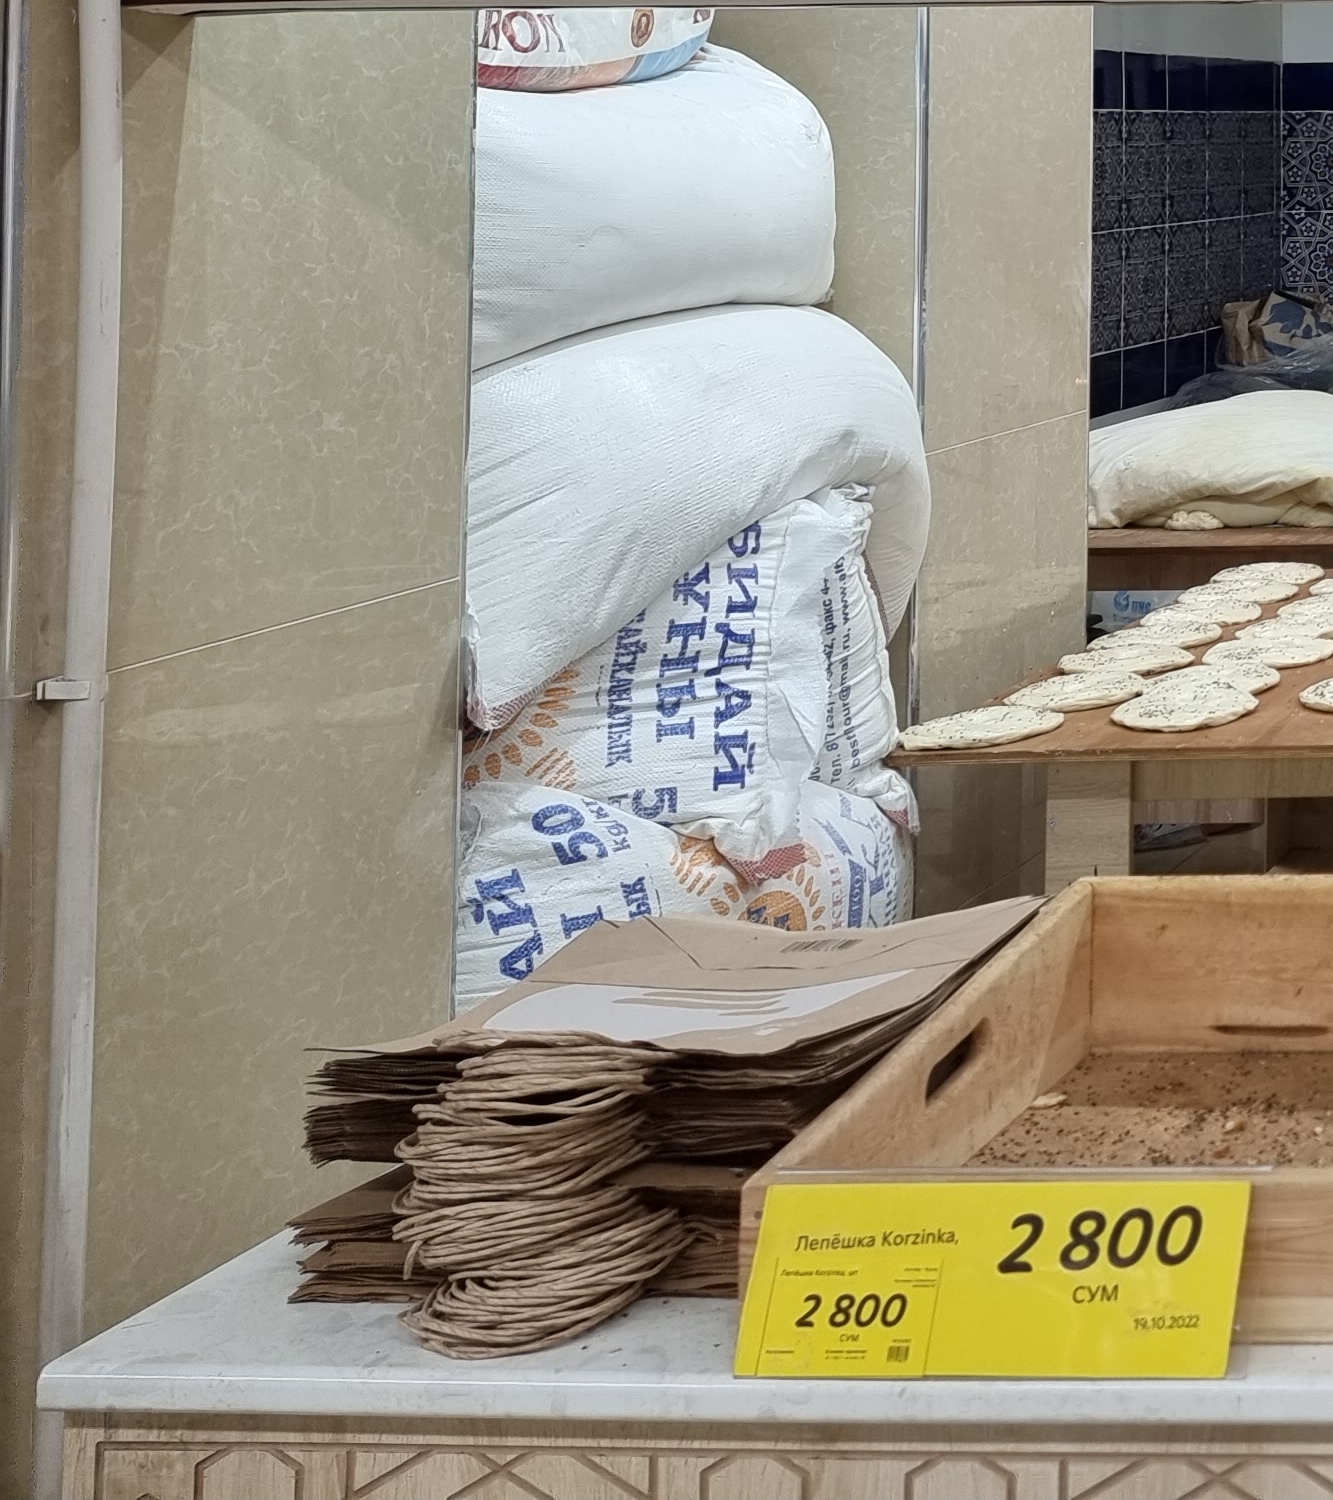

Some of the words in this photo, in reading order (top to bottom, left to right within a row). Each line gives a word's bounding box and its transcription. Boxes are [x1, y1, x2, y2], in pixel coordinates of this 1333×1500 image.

[531, 803, 608, 865] 50
[881, 1228, 960, 1248] Korzinka,
[996, 1212, 1046, 1275] 2
[1058, 1204, 1204, 1272] 800
[794, 1293, 823, 1328] 2
[828, 1292, 909, 1328] 800
[1072, 1283, 1119, 1305] СУМ
